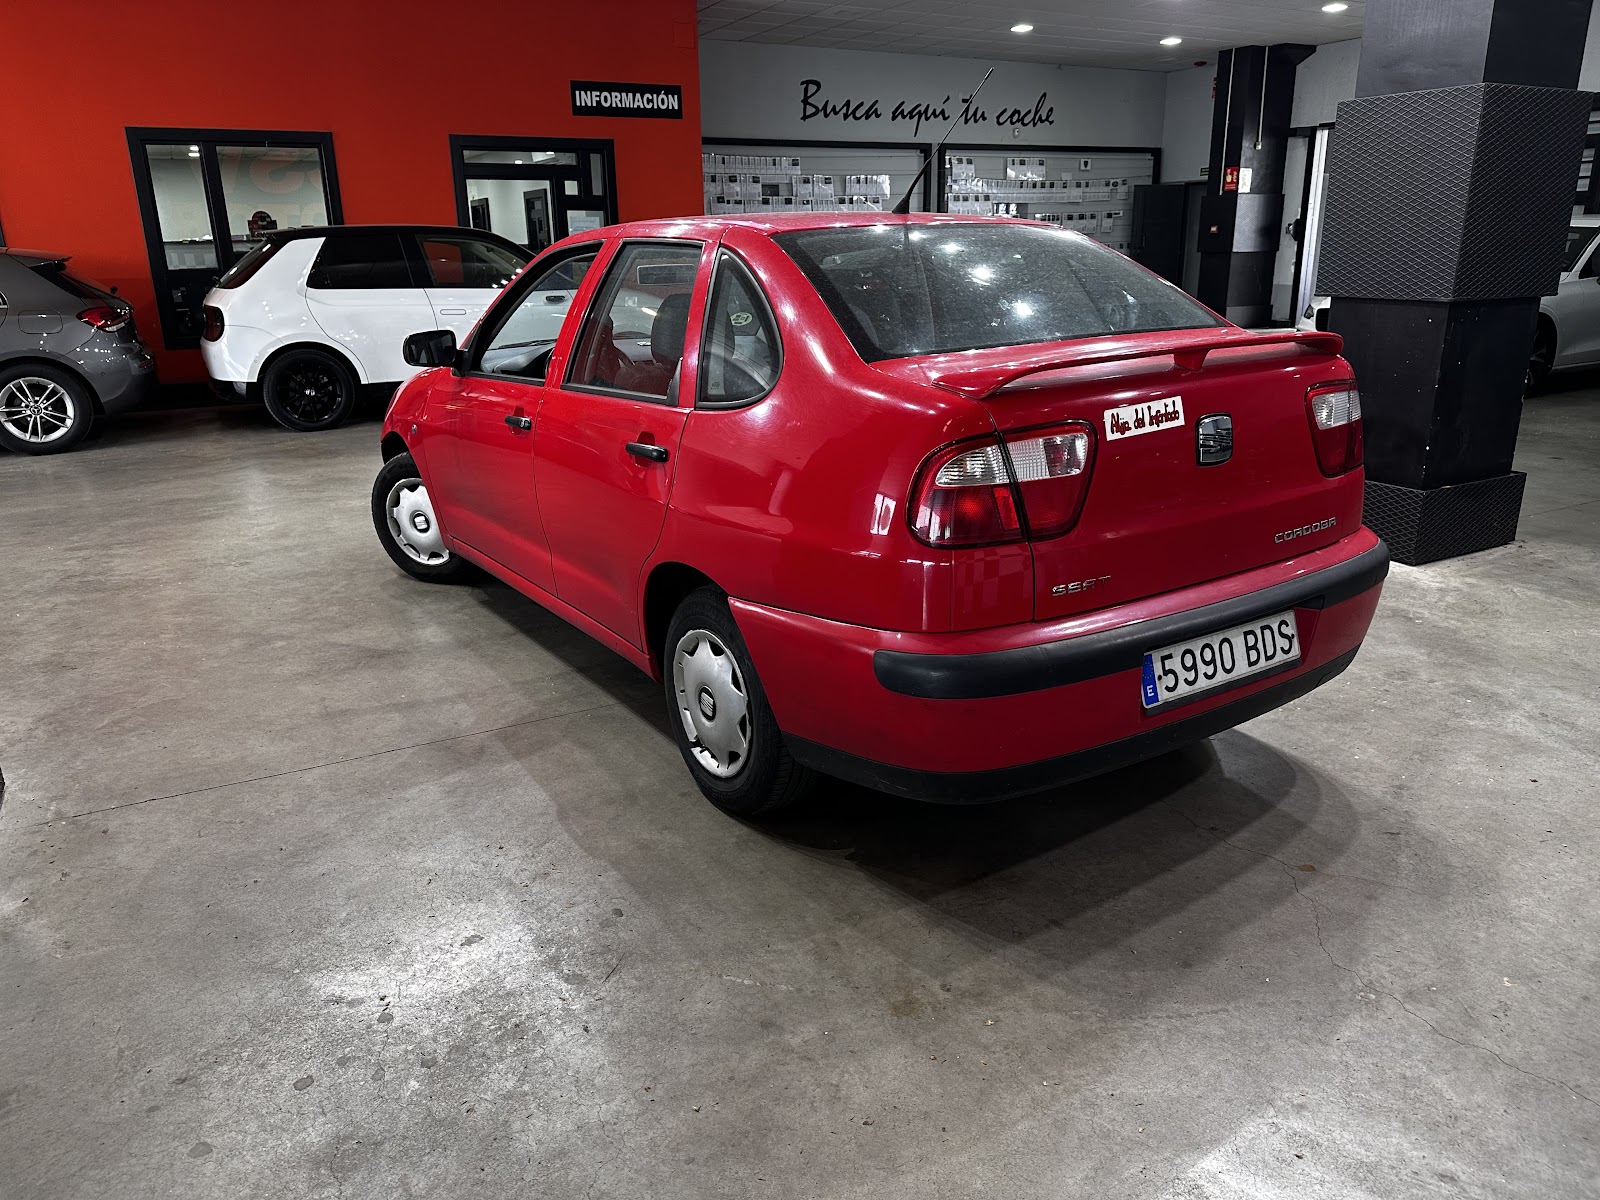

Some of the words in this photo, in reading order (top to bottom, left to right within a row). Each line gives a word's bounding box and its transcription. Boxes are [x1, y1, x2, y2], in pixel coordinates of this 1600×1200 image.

[575, 90, 679, 110] INFORMACIÓN
[800, 79, 882, 122] Busca
[891, 95, 950, 137] aquí
[961, 94, 987, 125] tu
[996, 91, 1055, 128] coche
[1134, 407, 1146, 430] del
[1274, 516, 1337, 544] CORDOBA
[1052, 575, 1112, 597] SEAT
[1160, 637, 1236, 693] 5990
[1242, 619, 1294, 668] BDS
[1146, 684, 1154, 697] E
